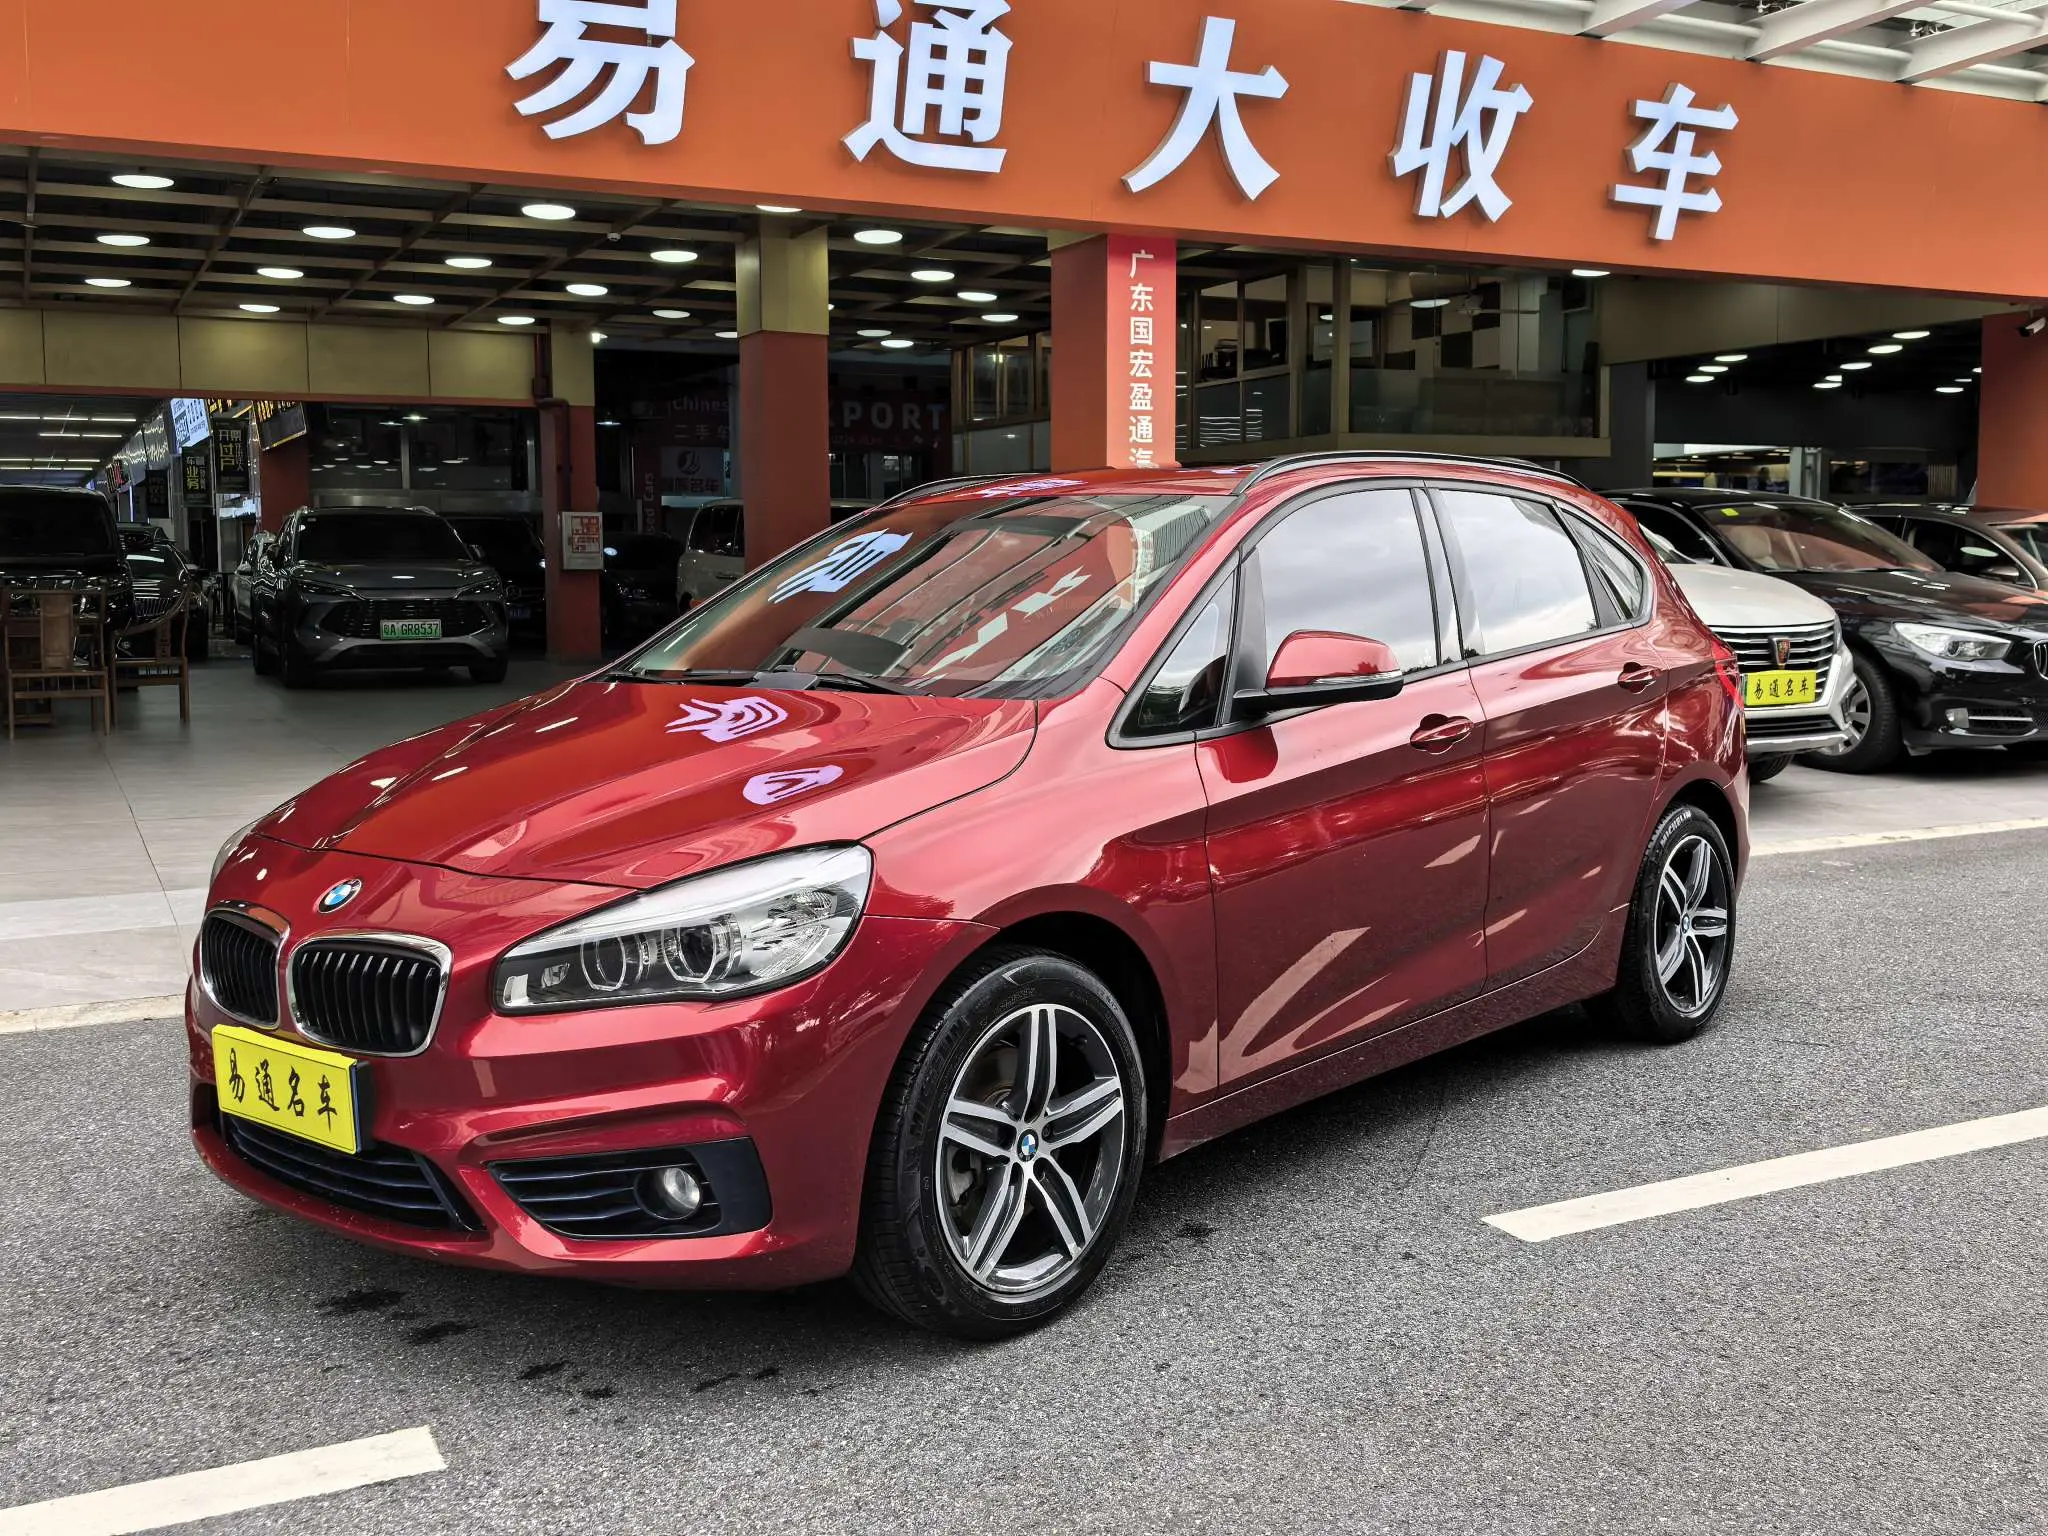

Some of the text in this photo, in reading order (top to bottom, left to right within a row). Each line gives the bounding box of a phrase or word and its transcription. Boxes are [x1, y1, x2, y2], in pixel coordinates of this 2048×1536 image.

[504, 0, 1739, 242] 易通大收车
[829, 400, 946, 432] PORT
[1754, 676, 1810, 701] 易通名车
[228, 1047, 338, 1132] 易通名车
